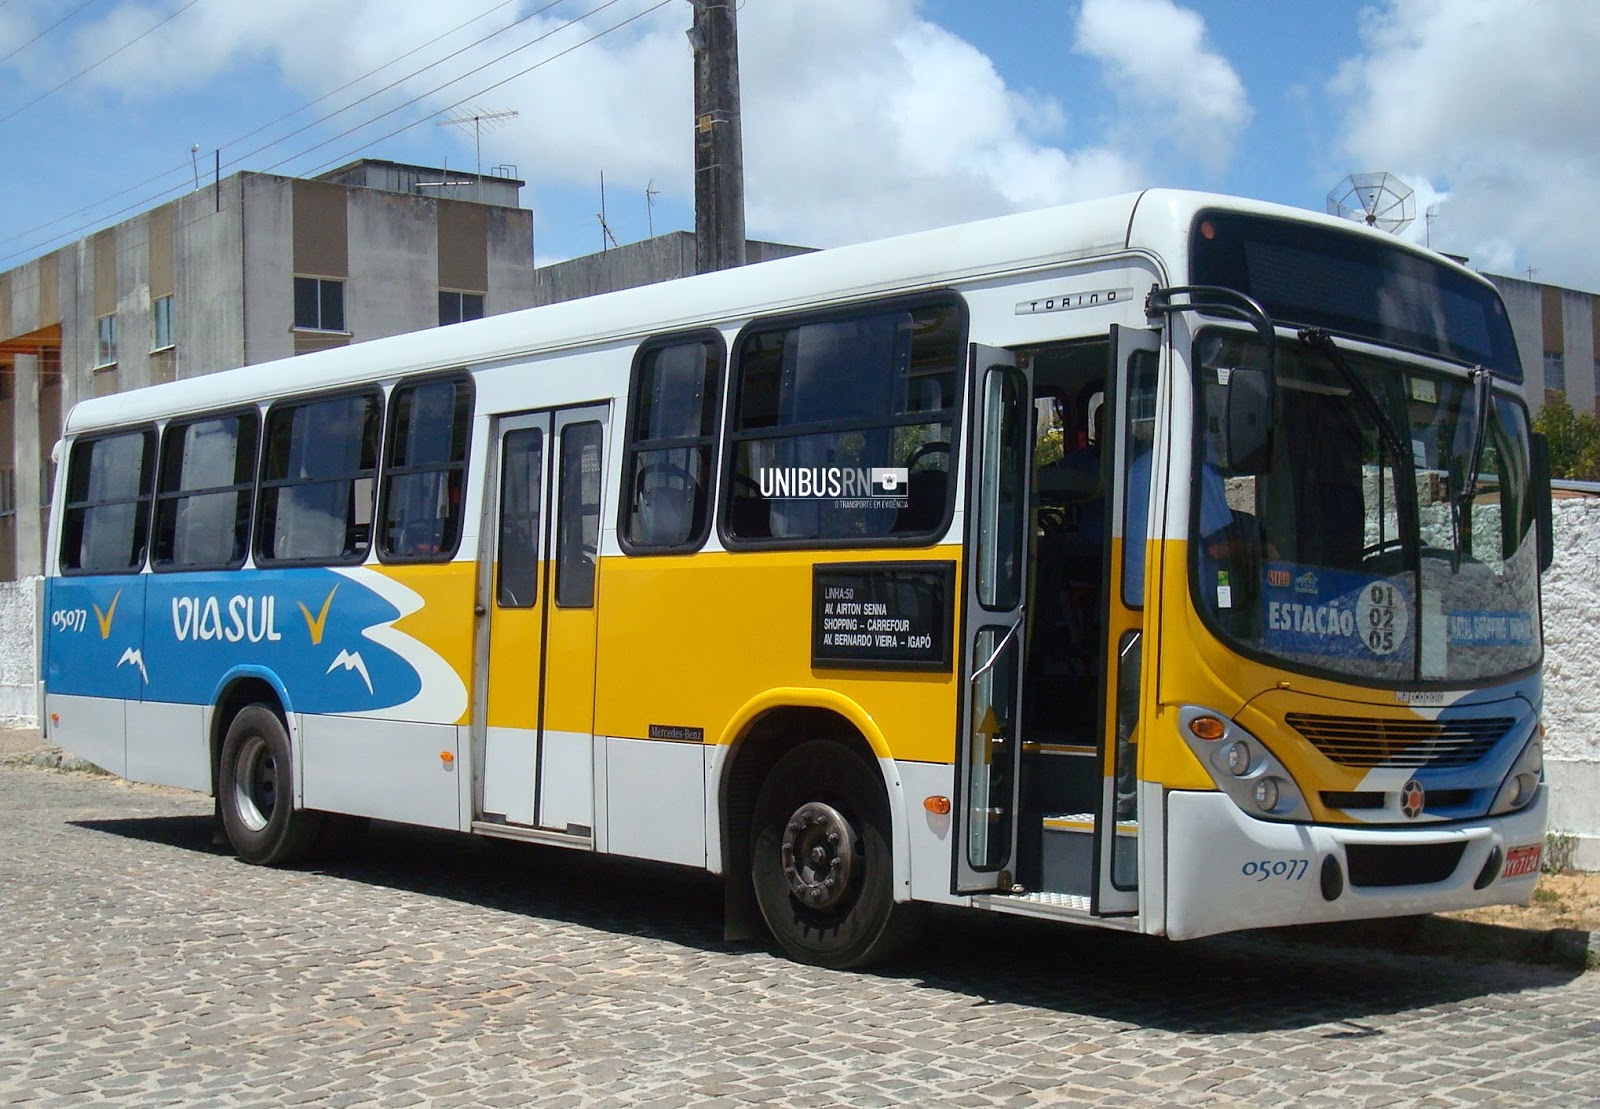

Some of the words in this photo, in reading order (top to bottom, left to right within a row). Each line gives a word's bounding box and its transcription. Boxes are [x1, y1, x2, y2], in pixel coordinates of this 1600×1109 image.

[1030, 291, 1116, 312] TORINO
[1370, 585, 1394, 605] 01
[824, 602, 834, 615] AV.
[836, 602, 861, 615] AIRTON
[863, 603, 887, 616] SENNA
[1268, 597, 1354, 639] ESTAÇÃO
[1369, 608, 1395, 628] 02
[52, 608, 87, 633] 05077
[823, 618, 858, 631] SHOPPING
[867, 618, 910, 632] CARREFOUR
[823, 633, 833, 646] AV.
[834, 633, 873, 647] BERNARDO
[875, 634, 898, 648] VIEIRA
[907, 632, 932, 649] IGAPÓ
[1368, 632, 1394, 652] 05
[651, 726, 702, 740] Mercedes-Benz
[1241, 858, 1310, 883] 05077
